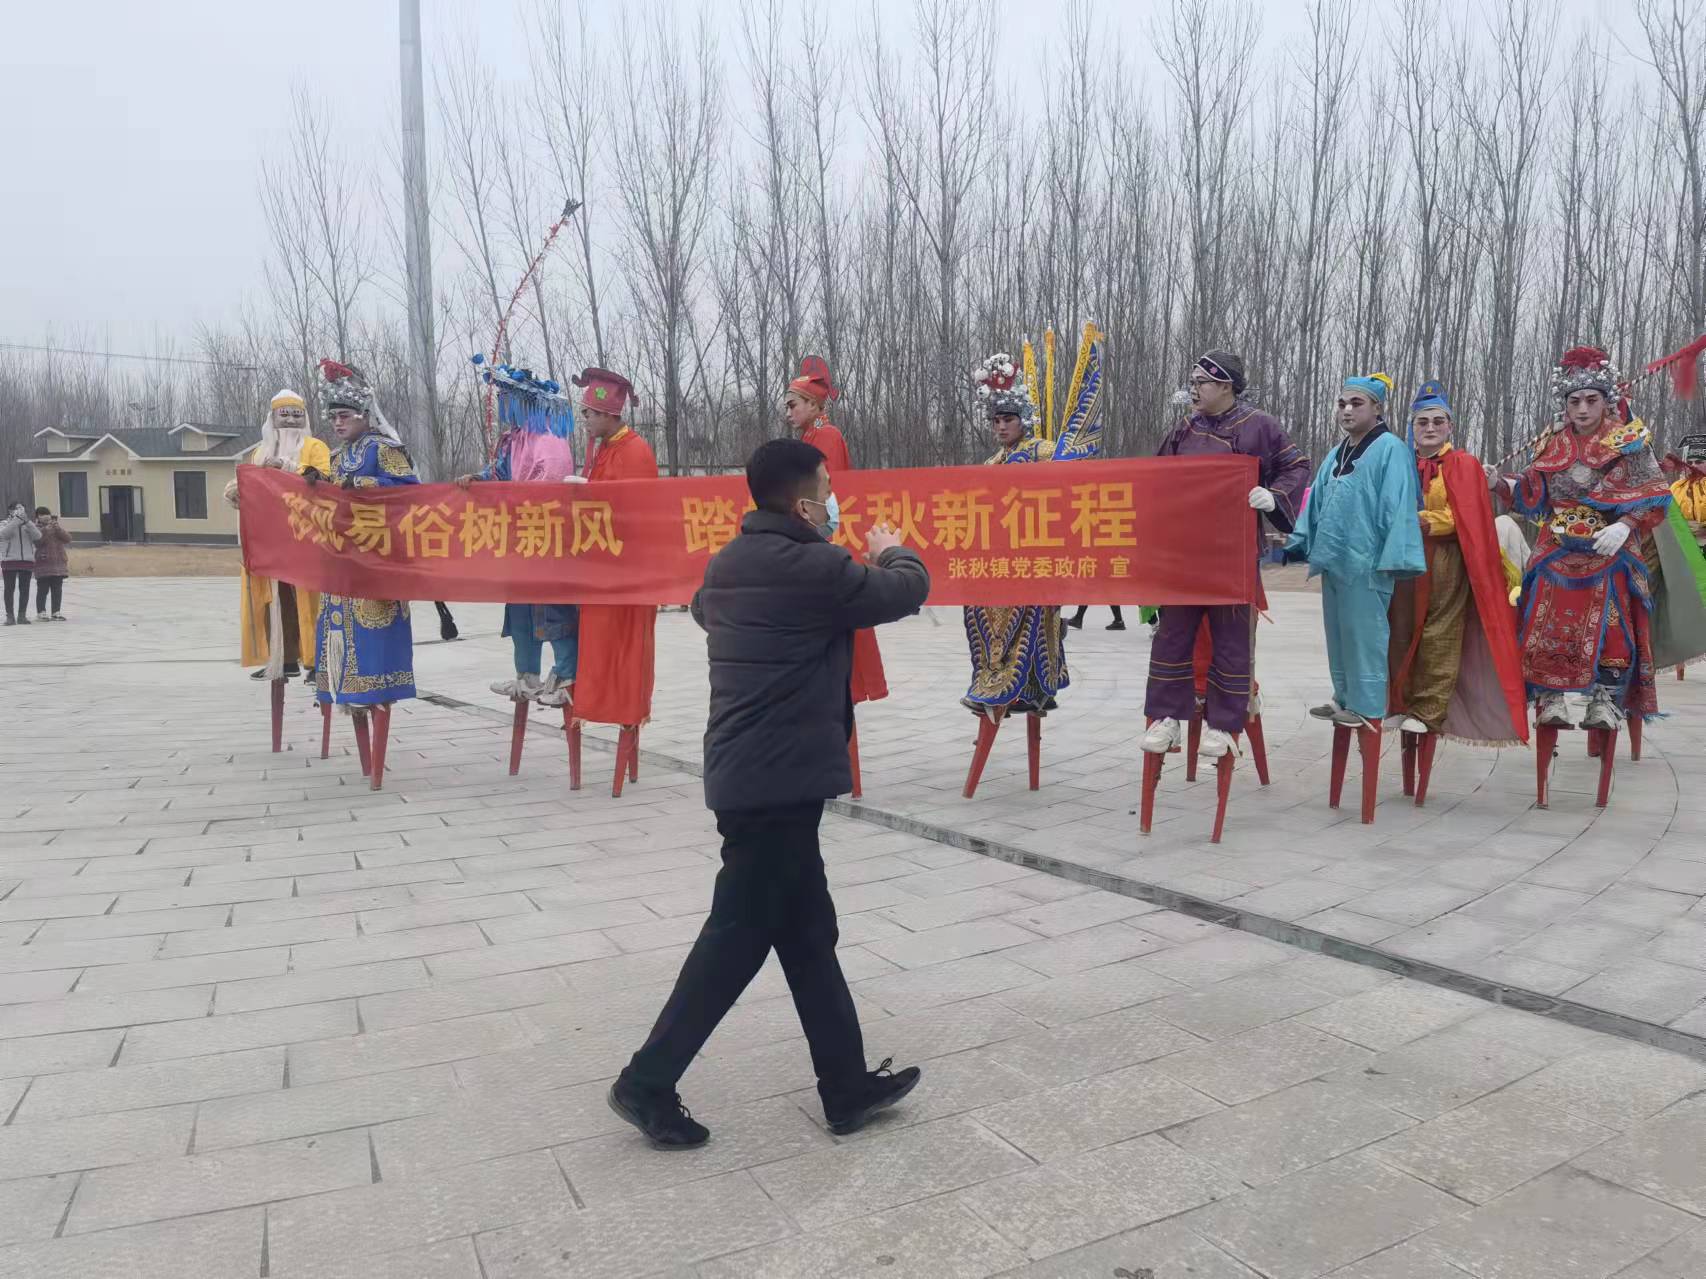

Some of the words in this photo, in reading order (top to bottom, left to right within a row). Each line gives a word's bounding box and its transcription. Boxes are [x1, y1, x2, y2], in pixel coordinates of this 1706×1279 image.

[682, 482, 1137, 556] 踏秋新征程
[947, 555, 1098, 579] 张秋镇党委政府
[1109, 555, 1131, 578] 宣
